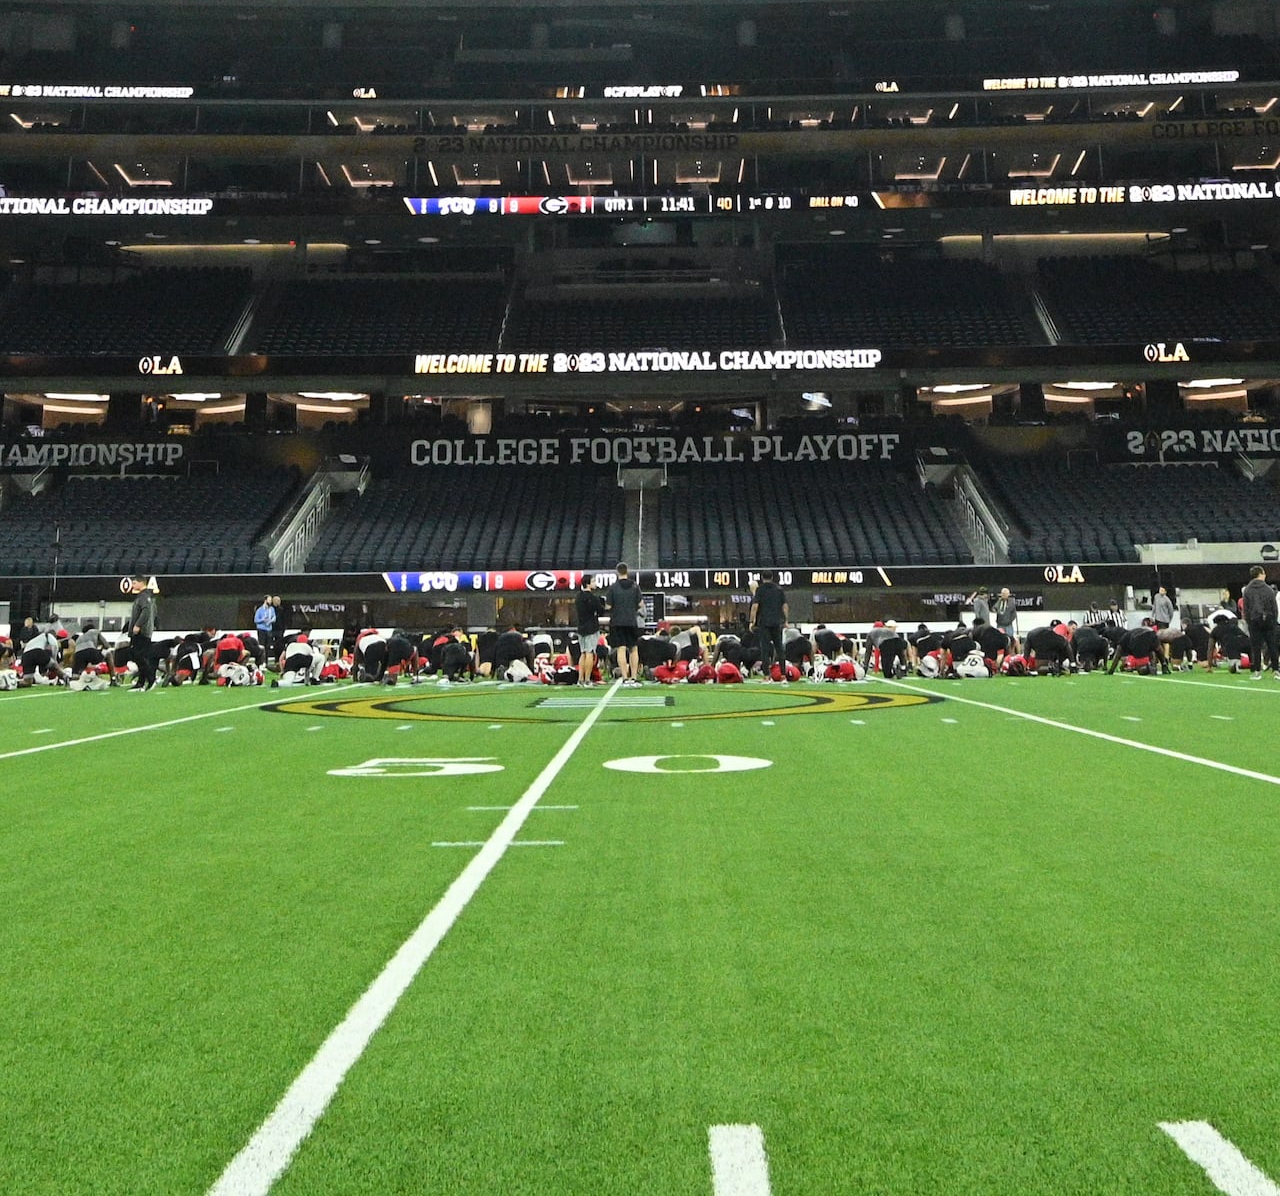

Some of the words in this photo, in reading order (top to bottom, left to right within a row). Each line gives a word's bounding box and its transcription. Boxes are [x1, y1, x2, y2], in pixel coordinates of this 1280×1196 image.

[438, 197, 475, 214] TCU
[604, 198, 625, 212] QTR
[661, 198, 696, 212] 11:41
[716, 197, 733, 211] 40
[778, 197, 792, 210] 10
[809, 197, 830, 209] BALL
[831, 197, 844, 208] ON
[844, 195, 859, 208] 40
[1010, 188, 1077, 205] WELCOME
[1079, 188, 1097, 203] TO
[1099, 187, 1125, 203] THE
[1177, 182, 1273, 201] NATIONAL
[72, 198, 213, 215] CHAMPIONSHIP
[415, 354, 493, 373] WELCOME
[496, 354, 516, 373] TO
[519, 354, 549, 372] THE
[608, 351, 717, 371] NATIONAL
[720, 349, 881, 370] CHAMPIONSHIP
[410, 439, 560, 467] COLLEGE
[570, 436, 745, 465] FOOTBALL
[751, 433, 901, 463] PLAYOFF
[418, 572, 459, 592] TCU
[473, 573, 482, 589] 9
[494, 573, 504, 588] 9
[654, 571, 692, 588] 11:41
[713, 572, 730, 586] 40
[778, 571, 792, 586] 10
[811, 571, 833, 584] BALL
[834, 571, 847, 584] ON
[848, 571, 864, 584] 40
